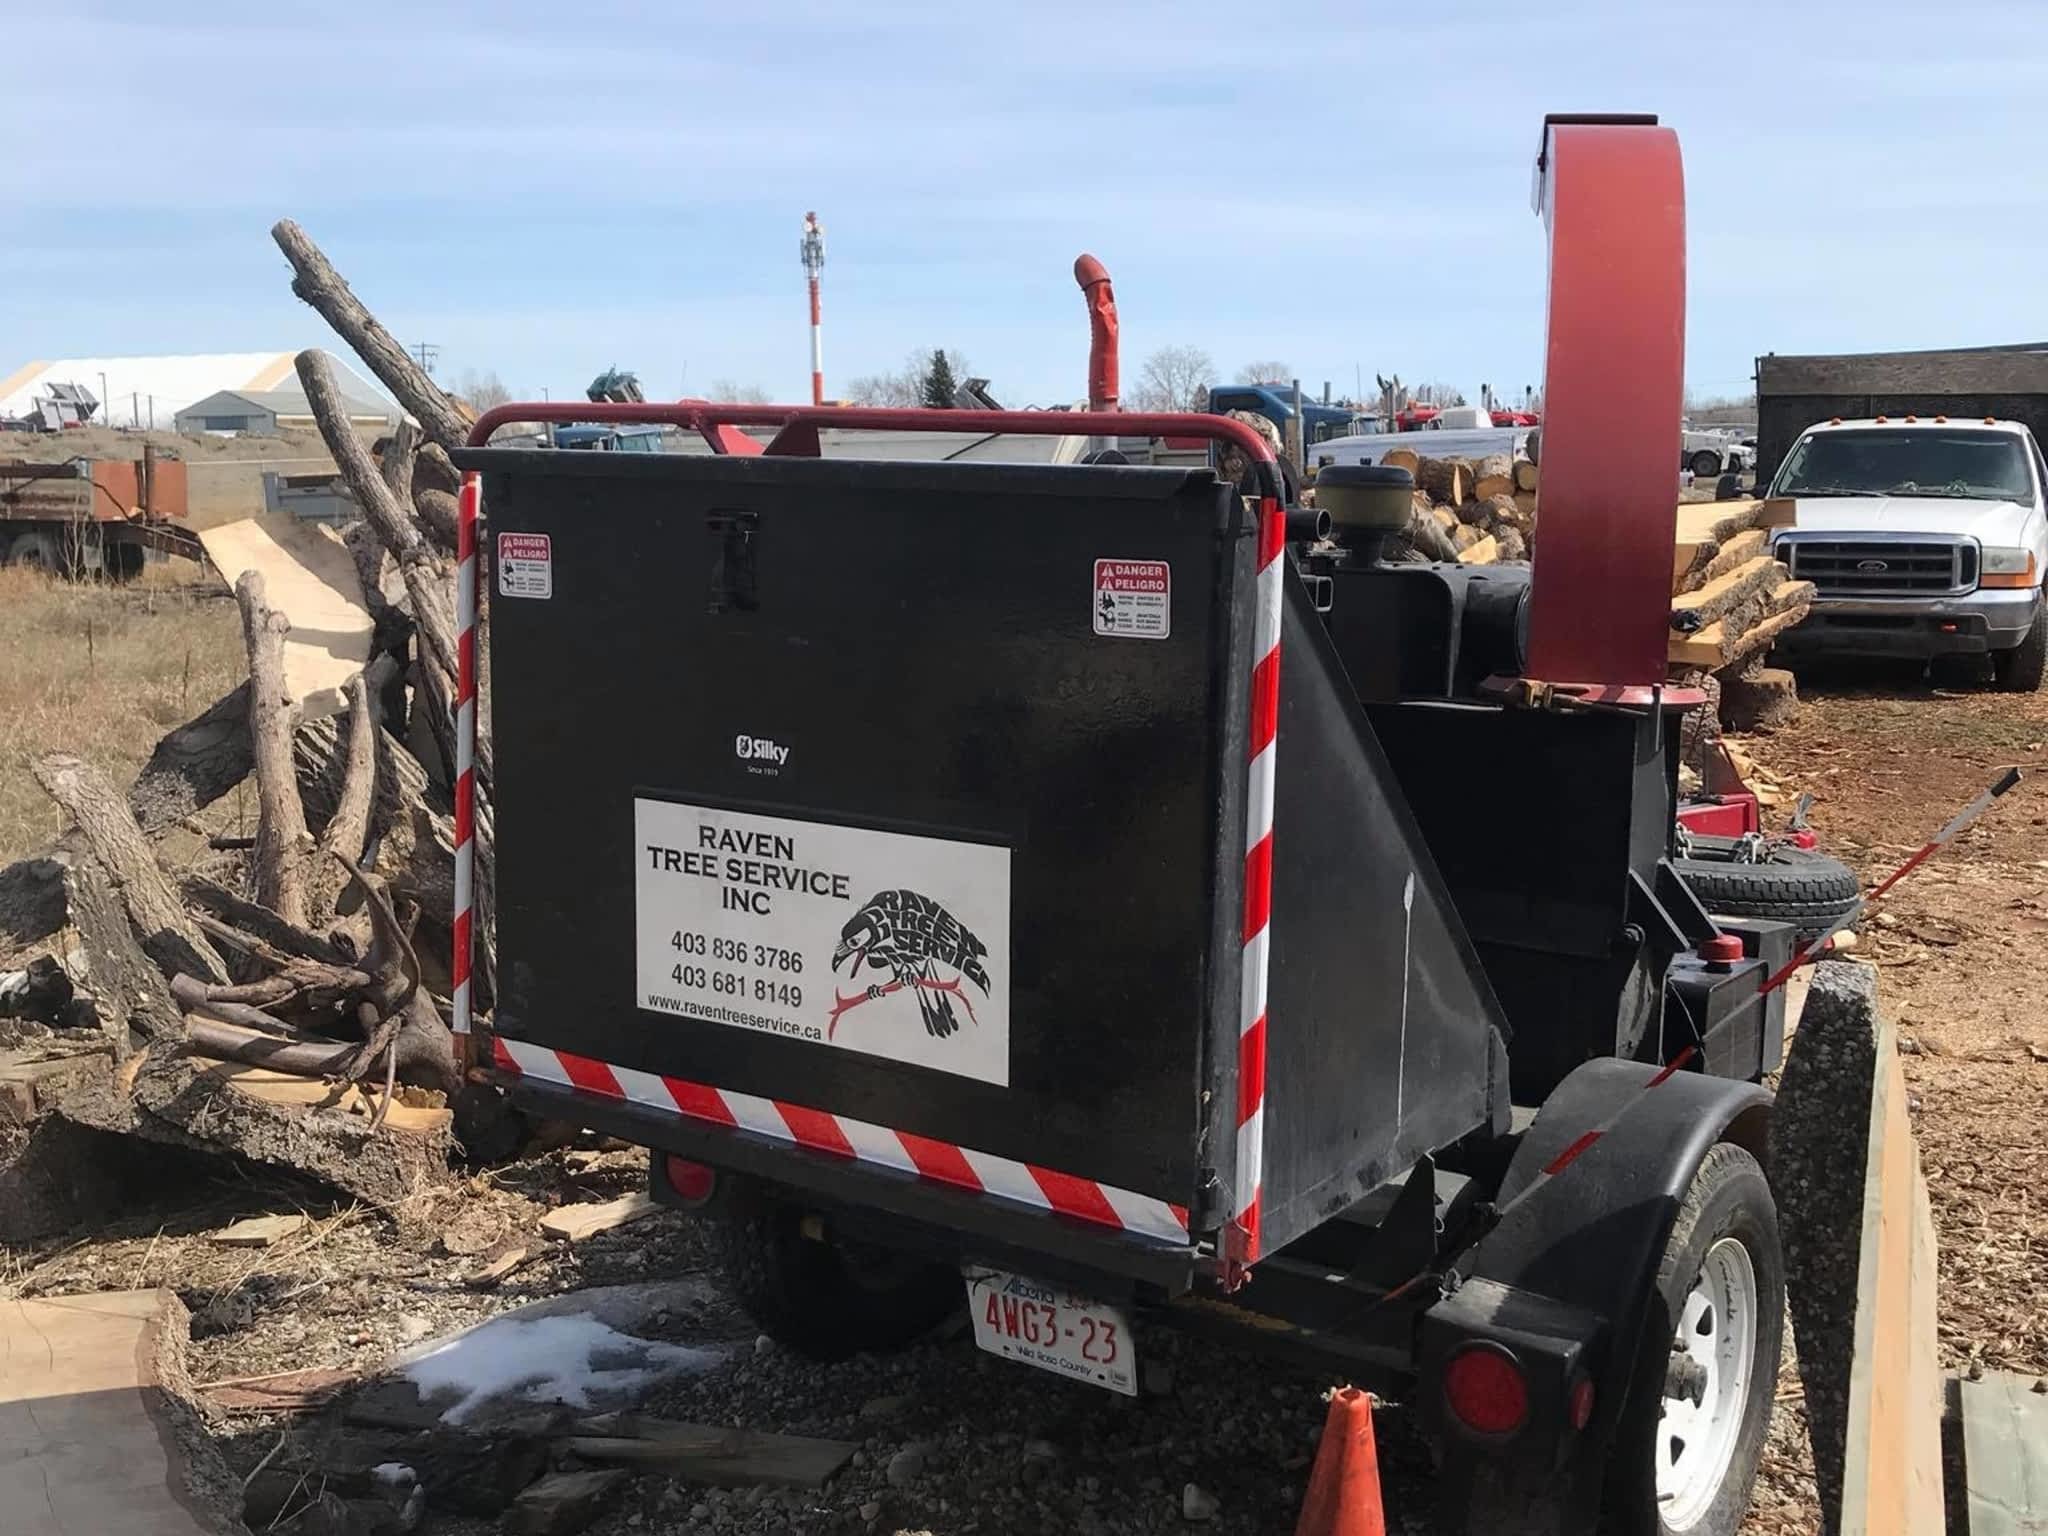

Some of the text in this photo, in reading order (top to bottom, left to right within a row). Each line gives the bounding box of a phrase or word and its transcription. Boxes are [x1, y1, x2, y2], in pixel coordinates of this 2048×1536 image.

[512, 537, 546, 548] DANGER
[512, 549, 548, 559] PELIGRO
[1114, 579, 1165, 591] PELIGRO
[1115, 565, 1163, 577] DANGER
[753, 739, 790, 765] Silky
[699, 825, 794, 861] RAVEN
[647, 846, 850, 900] TREE SERVICE
[722, 886, 771, 916] INC
[671, 931, 803, 974] 403 836 3786
[671, 963, 803, 1008] 403 681 8149
[648, 994, 822, 1041] www.raventreeservice.ca
[986, 1291, 1118, 1364] 4WG3-23
[1059, 1358, 1094, 1377] Country
